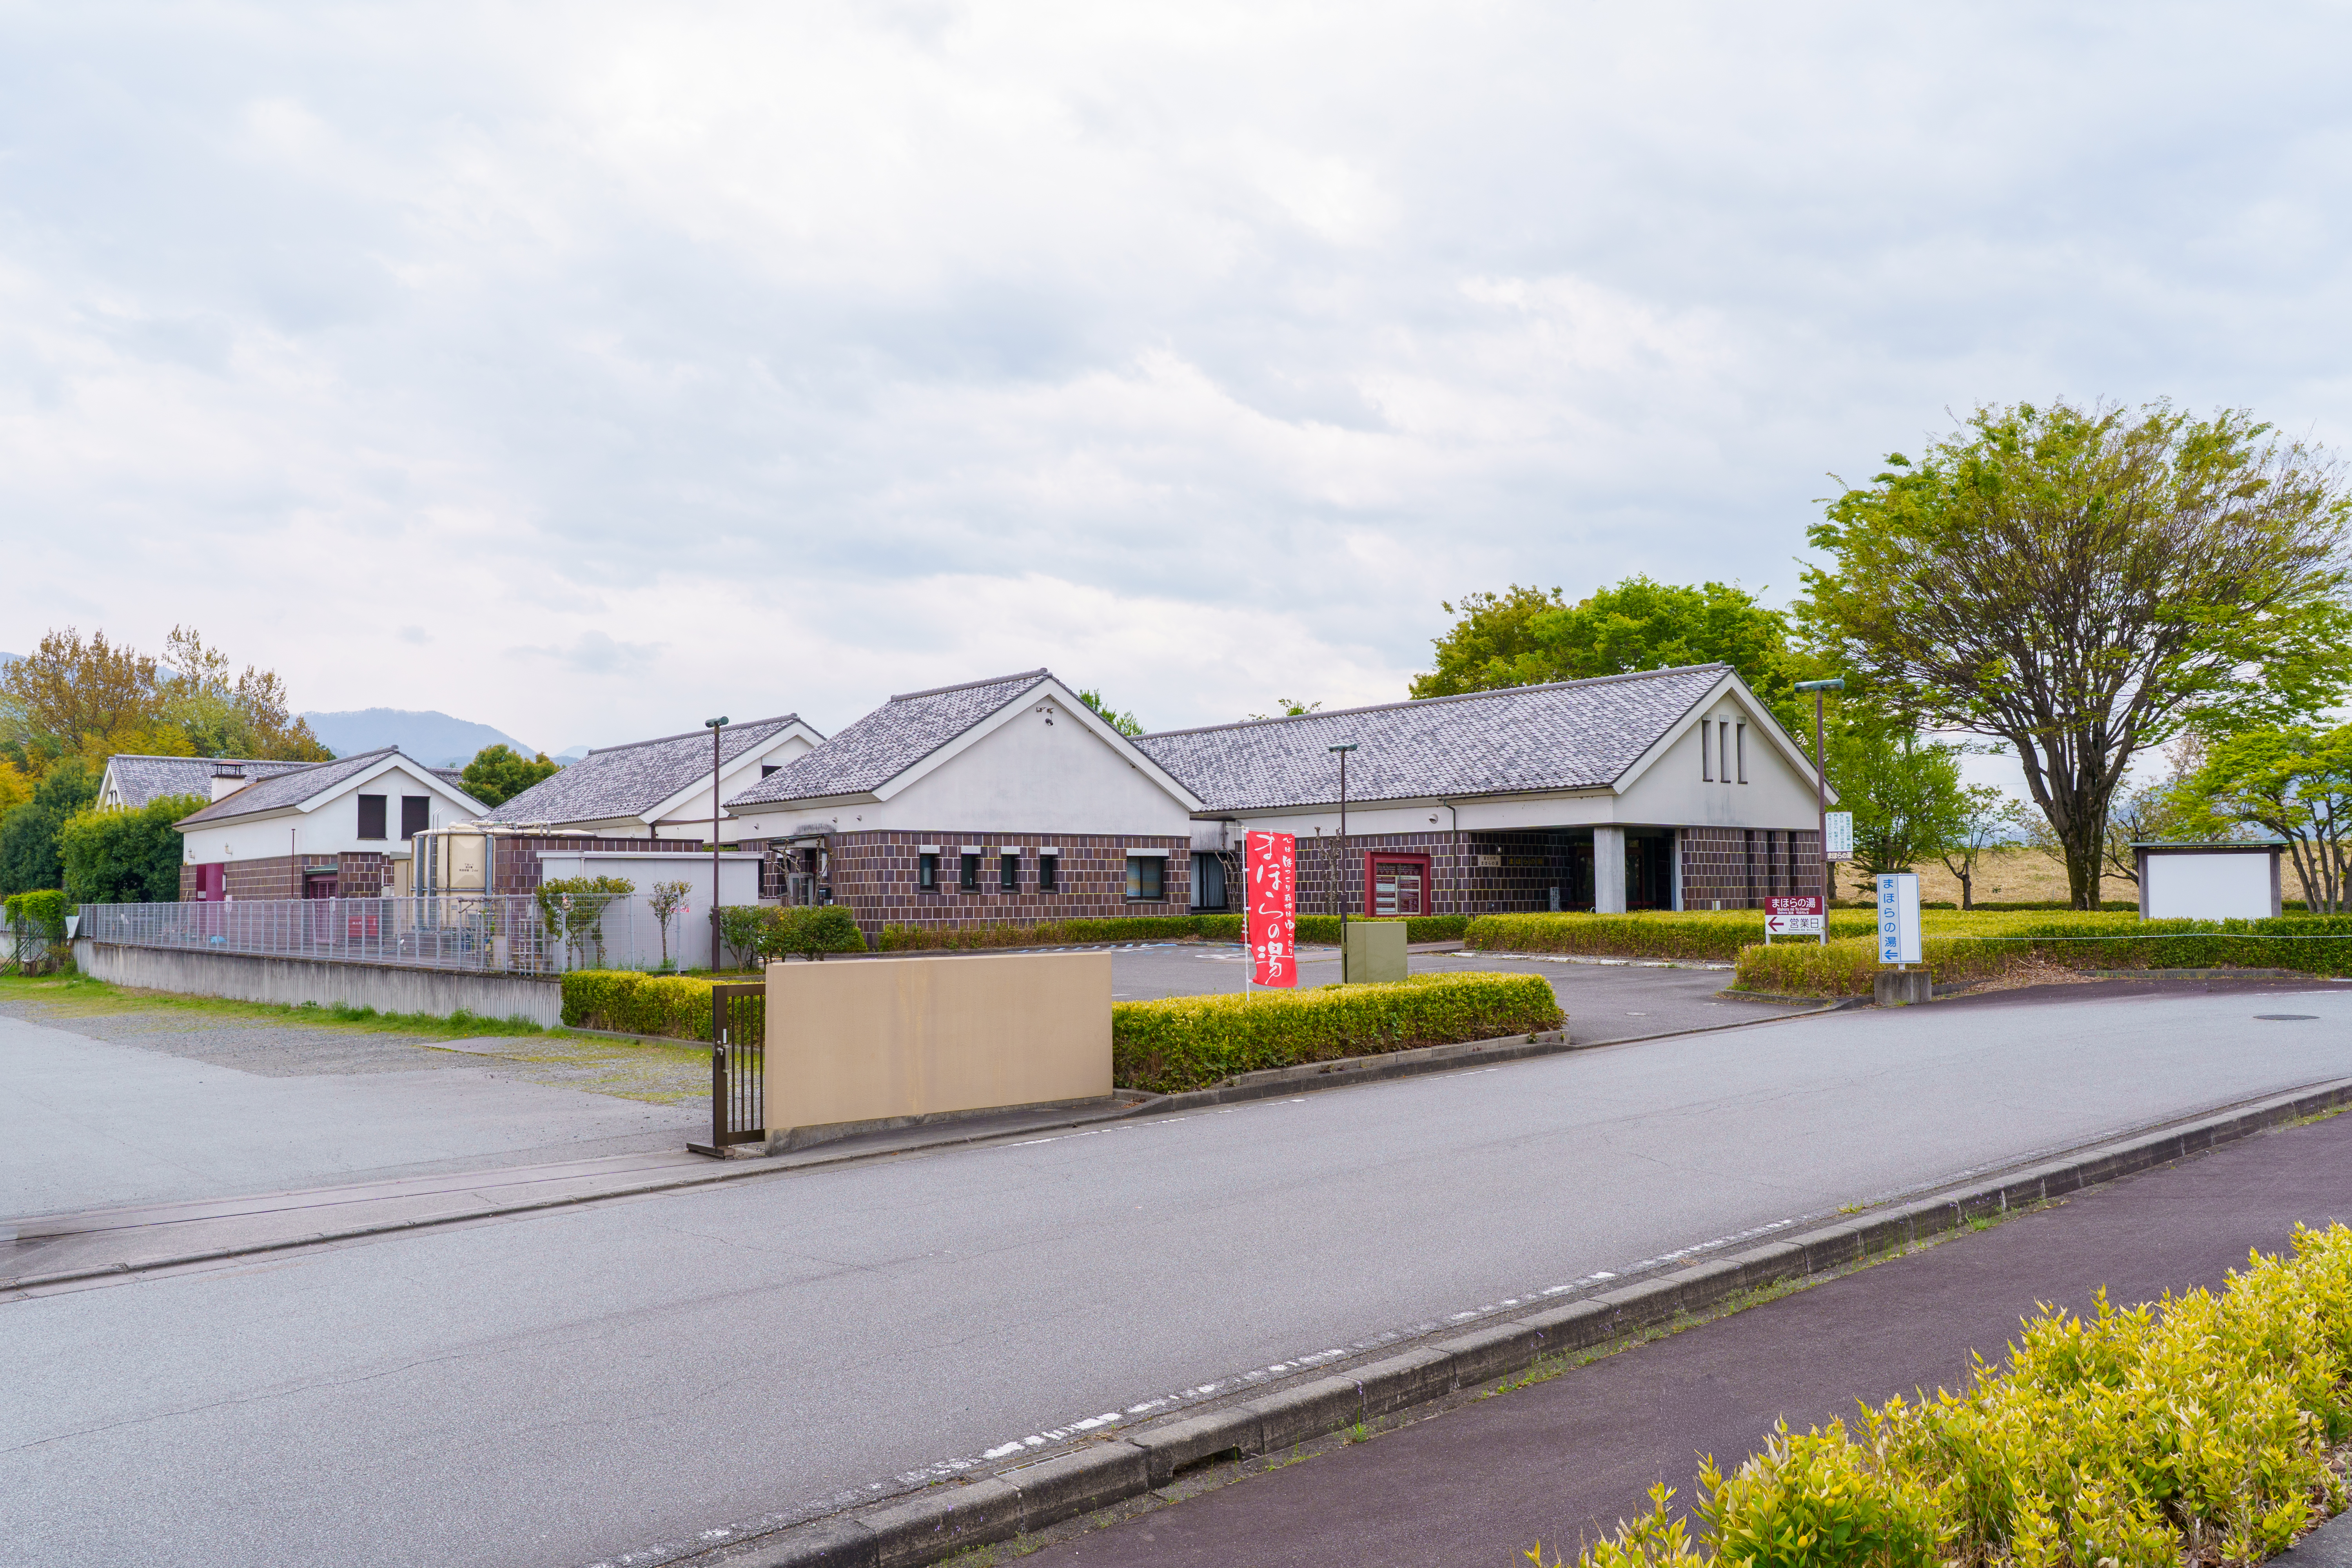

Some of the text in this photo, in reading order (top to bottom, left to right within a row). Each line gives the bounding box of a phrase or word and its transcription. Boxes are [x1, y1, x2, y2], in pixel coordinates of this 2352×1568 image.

[1254, 834, 1293, 984] まほらの湯
[1772, 898, 1816, 908] まほらの湯
[1883, 878, 1896, 947] まほらの湯
[1790, 918, 1818, 928] 営業日
